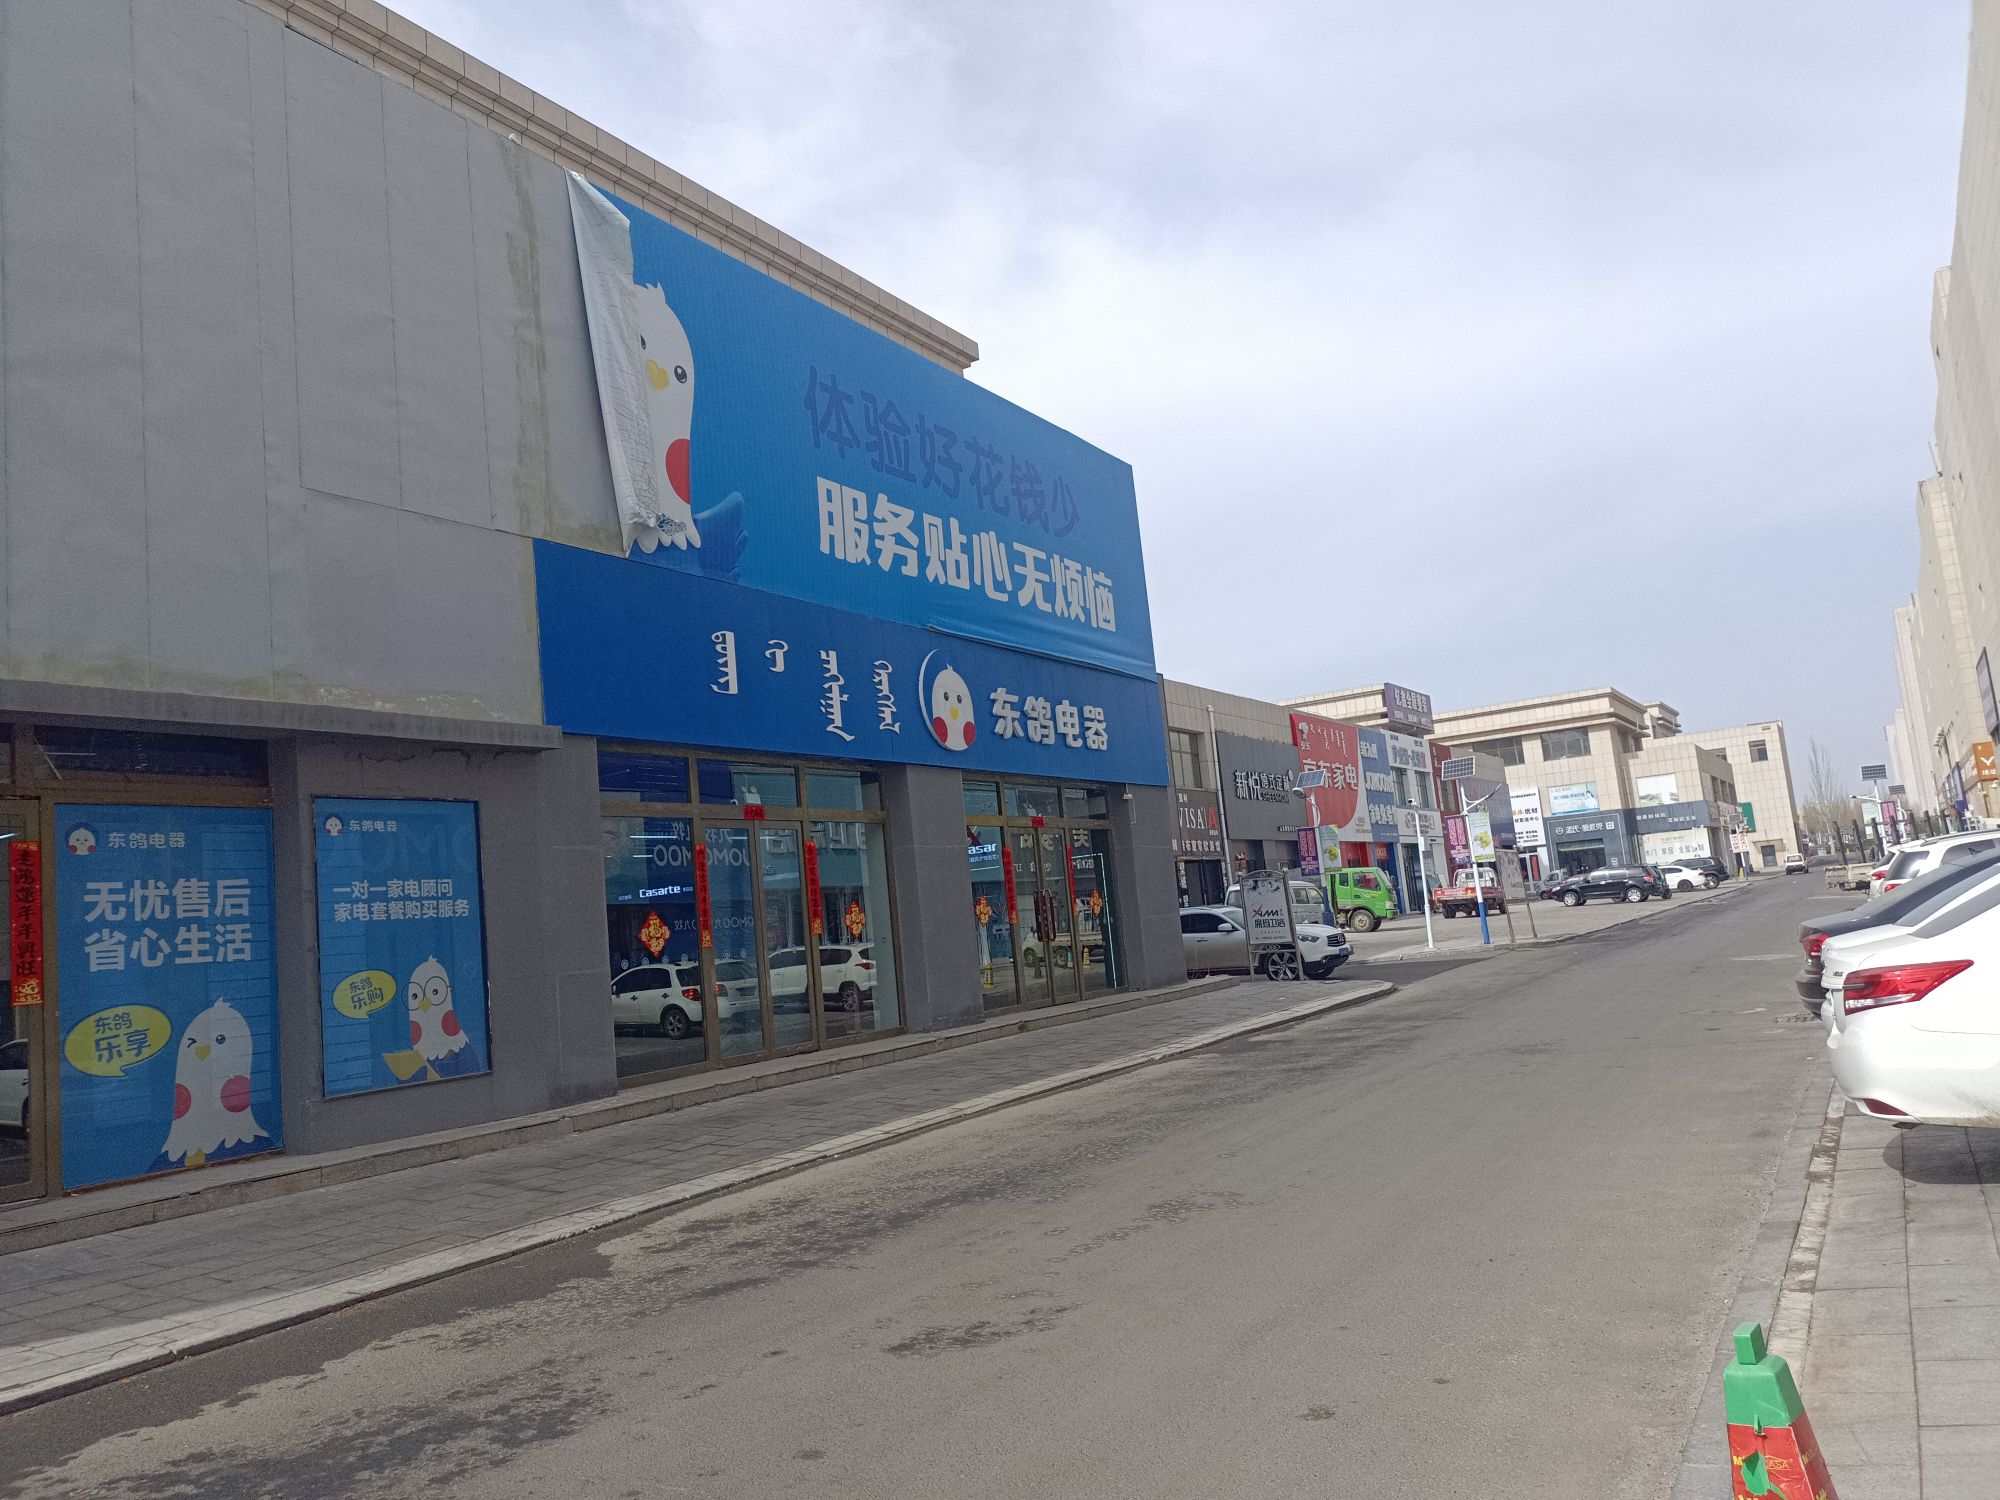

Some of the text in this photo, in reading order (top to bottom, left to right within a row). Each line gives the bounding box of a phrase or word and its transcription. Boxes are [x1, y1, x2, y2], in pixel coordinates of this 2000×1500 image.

[804, 366, 1080, 537] 体验好花钱少
[817, 475, 1116, 632] 服务贴心无烦恼
[990, 687, 1108, 751] 东鸽电器
[349, 820, 397, 832] 东鸽电器
[108, 832, 186, 849] 东鸽电器
[84, 878, 251, 923] 无忧售后
[333, 879, 453, 899] 一对一家电顾问
[639, 885, 681, 898] Casarte
[334, 899, 469, 922] 家电套餐购买服务
[84, 924, 252, 972] 省心生活
[349, 976, 373, 993] 东鸽
[351, 987, 384, 1010] 乐购
[95, 1012, 132, 1034] 东鸽
[95, 1027, 151, 1063] 乐享
